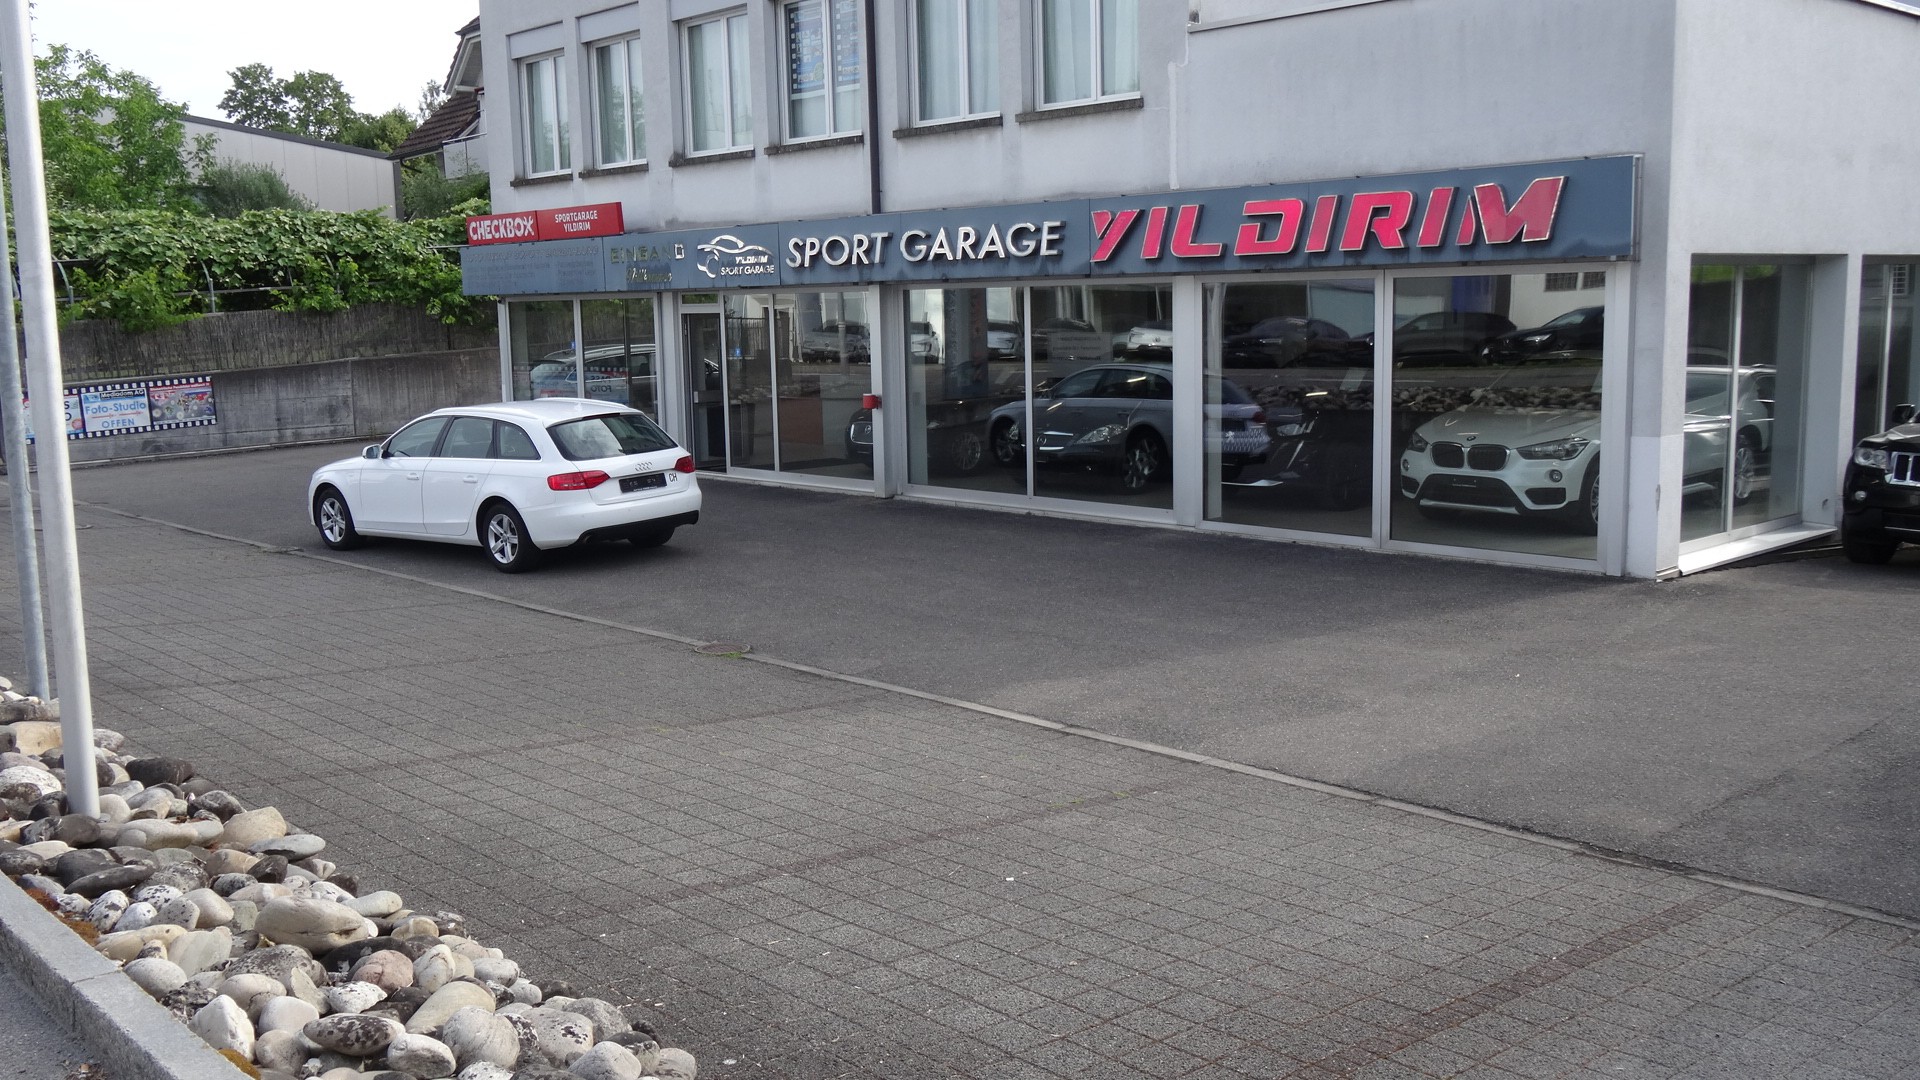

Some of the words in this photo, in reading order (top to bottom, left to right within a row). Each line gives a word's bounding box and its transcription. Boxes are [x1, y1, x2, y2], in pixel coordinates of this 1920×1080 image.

[555, 210, 598, 223] SPORTGARAGE
[1090, 176, 1568, 262] YILDIRIM
[469, 215, 534, 241] CHECKBOX
[563, 222, 591, 232] YILDIRIM
[786, 232, 892, 268] SPORT
[900, 220, 1066, 262] GARAGE
[720, 266, 743, 275] SPORT
[744, 264, 775, 274] GARAGE
[85, 401, 146, 414] Foto-Studio
[101, 418, 135, 428] OFFEN
[668, 473, 678, 482] CH
